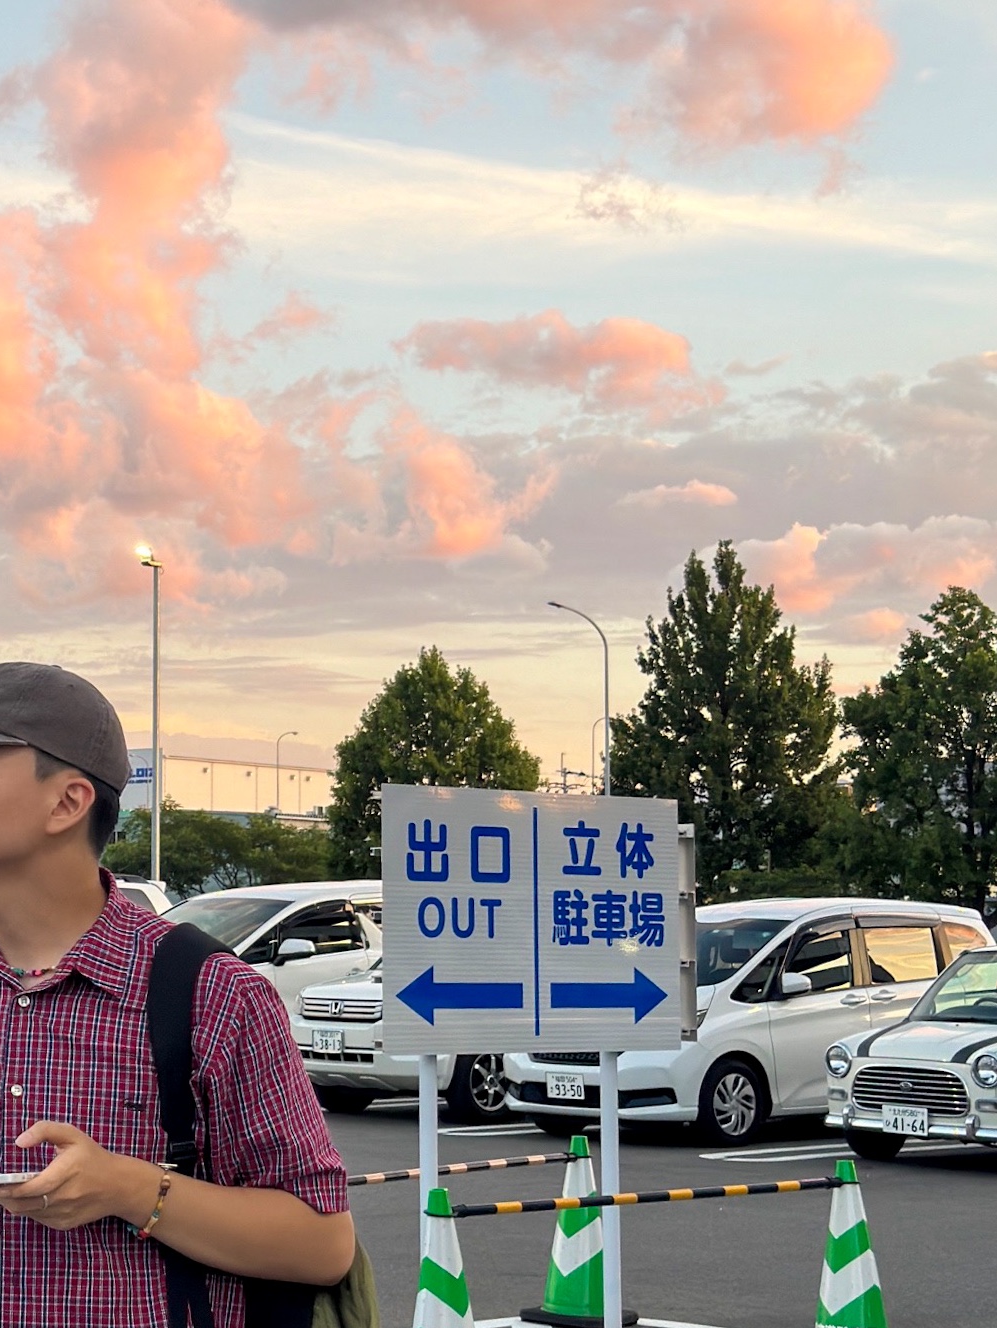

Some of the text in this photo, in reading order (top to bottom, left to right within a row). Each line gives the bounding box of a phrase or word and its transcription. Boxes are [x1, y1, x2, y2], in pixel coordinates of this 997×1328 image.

[406, 818, 512, 884] 出口
[561, 820, 655, 879] 立体
[417, 896, 502, 939] OUT
[551, 888, 666, 948] 駐車場
[555, 1083, 583, 1098] 93-50
[892, 1116, 926, 1134] 41-64
